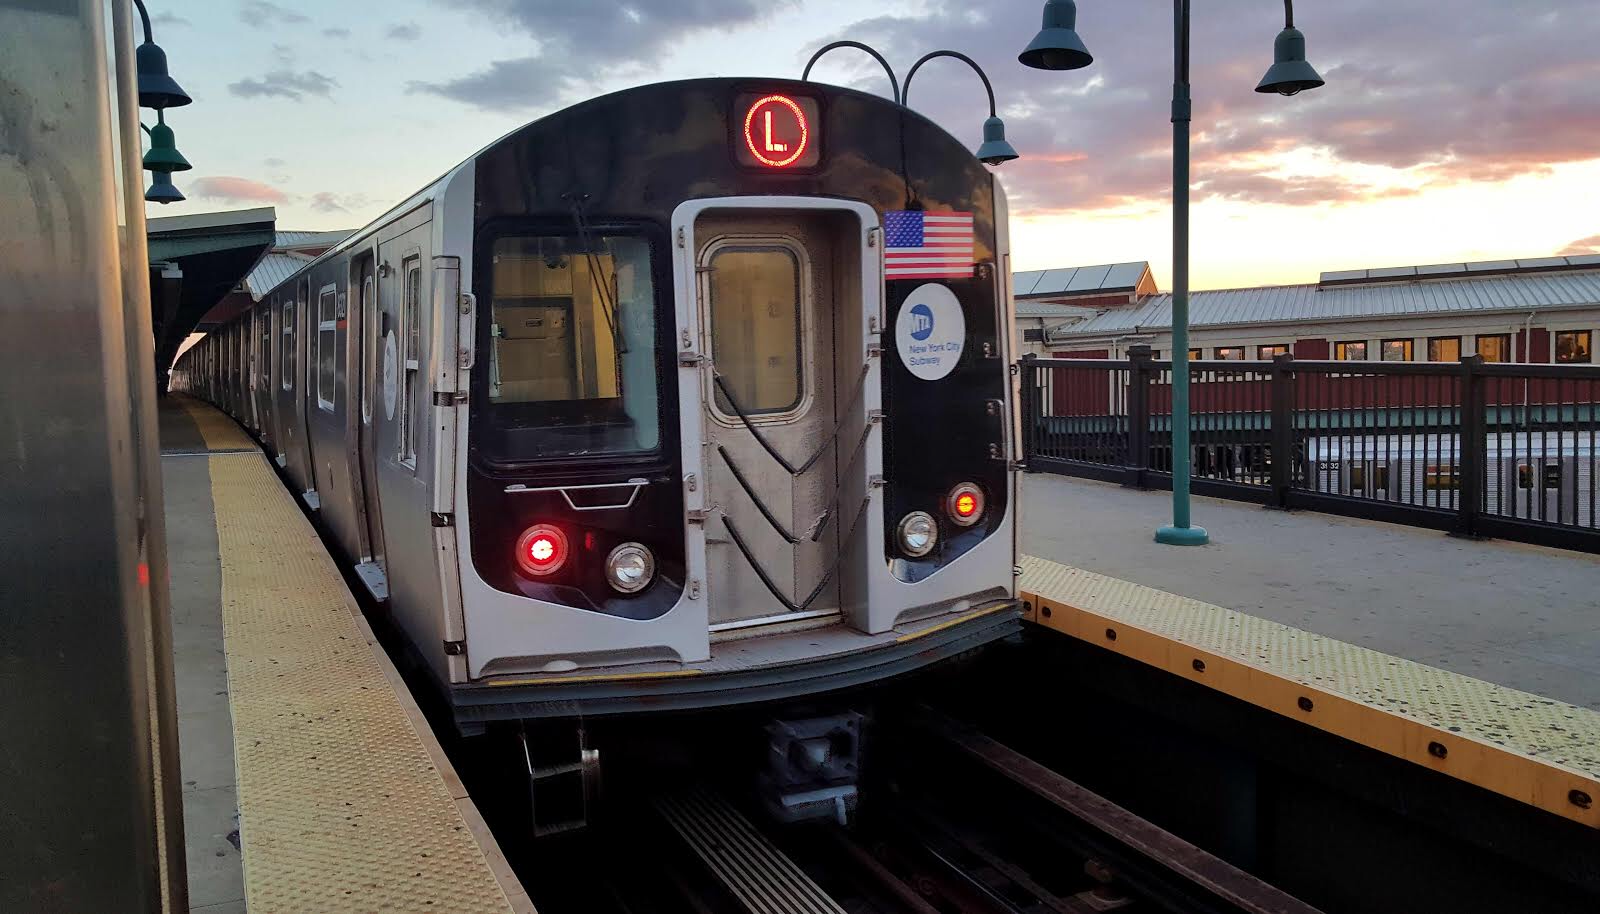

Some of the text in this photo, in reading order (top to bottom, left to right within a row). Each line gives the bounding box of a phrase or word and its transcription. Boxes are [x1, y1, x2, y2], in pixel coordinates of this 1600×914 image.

[765, 111, 787, 151] L
[909, 342, 960, 353] New York City
[909, 357, 940, 366] Subway
